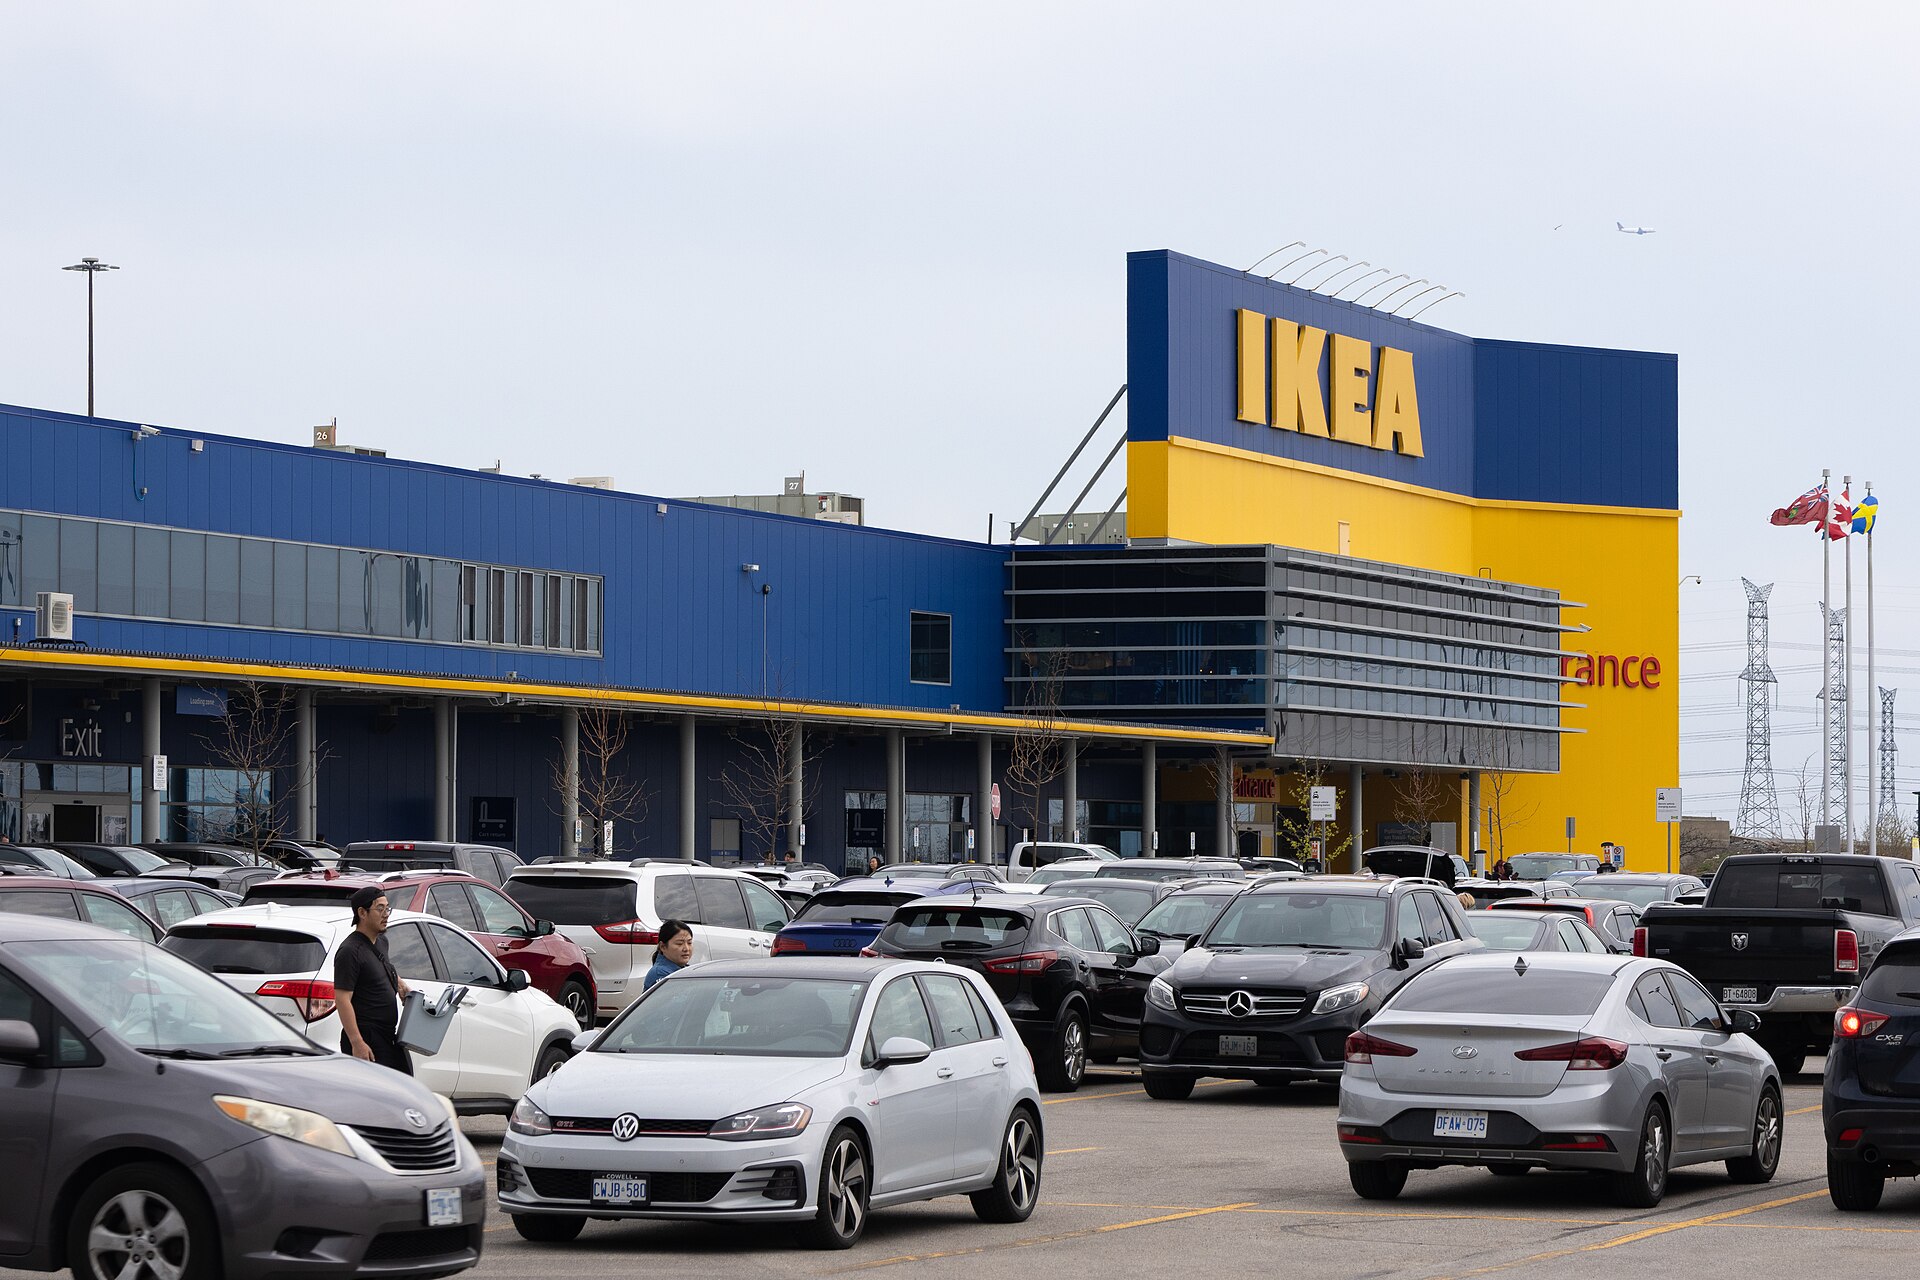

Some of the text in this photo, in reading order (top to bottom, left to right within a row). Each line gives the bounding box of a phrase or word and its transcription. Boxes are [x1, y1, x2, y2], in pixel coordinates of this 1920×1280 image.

[1237, 308, 1425, 458] IKEA
[316, 431, 328, 441] 26
[788, 482, 799, 490] 27
[190, 697, 205, 707] Loading
[62, 718, 102, 757] Exit
[991, 795, 1001, 807] STOP
[1417, 1067, 1511, 1076] ELANTRA
[1436, 1116, 1486, 1132] DFAW 075
[593, 1182, 647, 1198] CWJB 580
